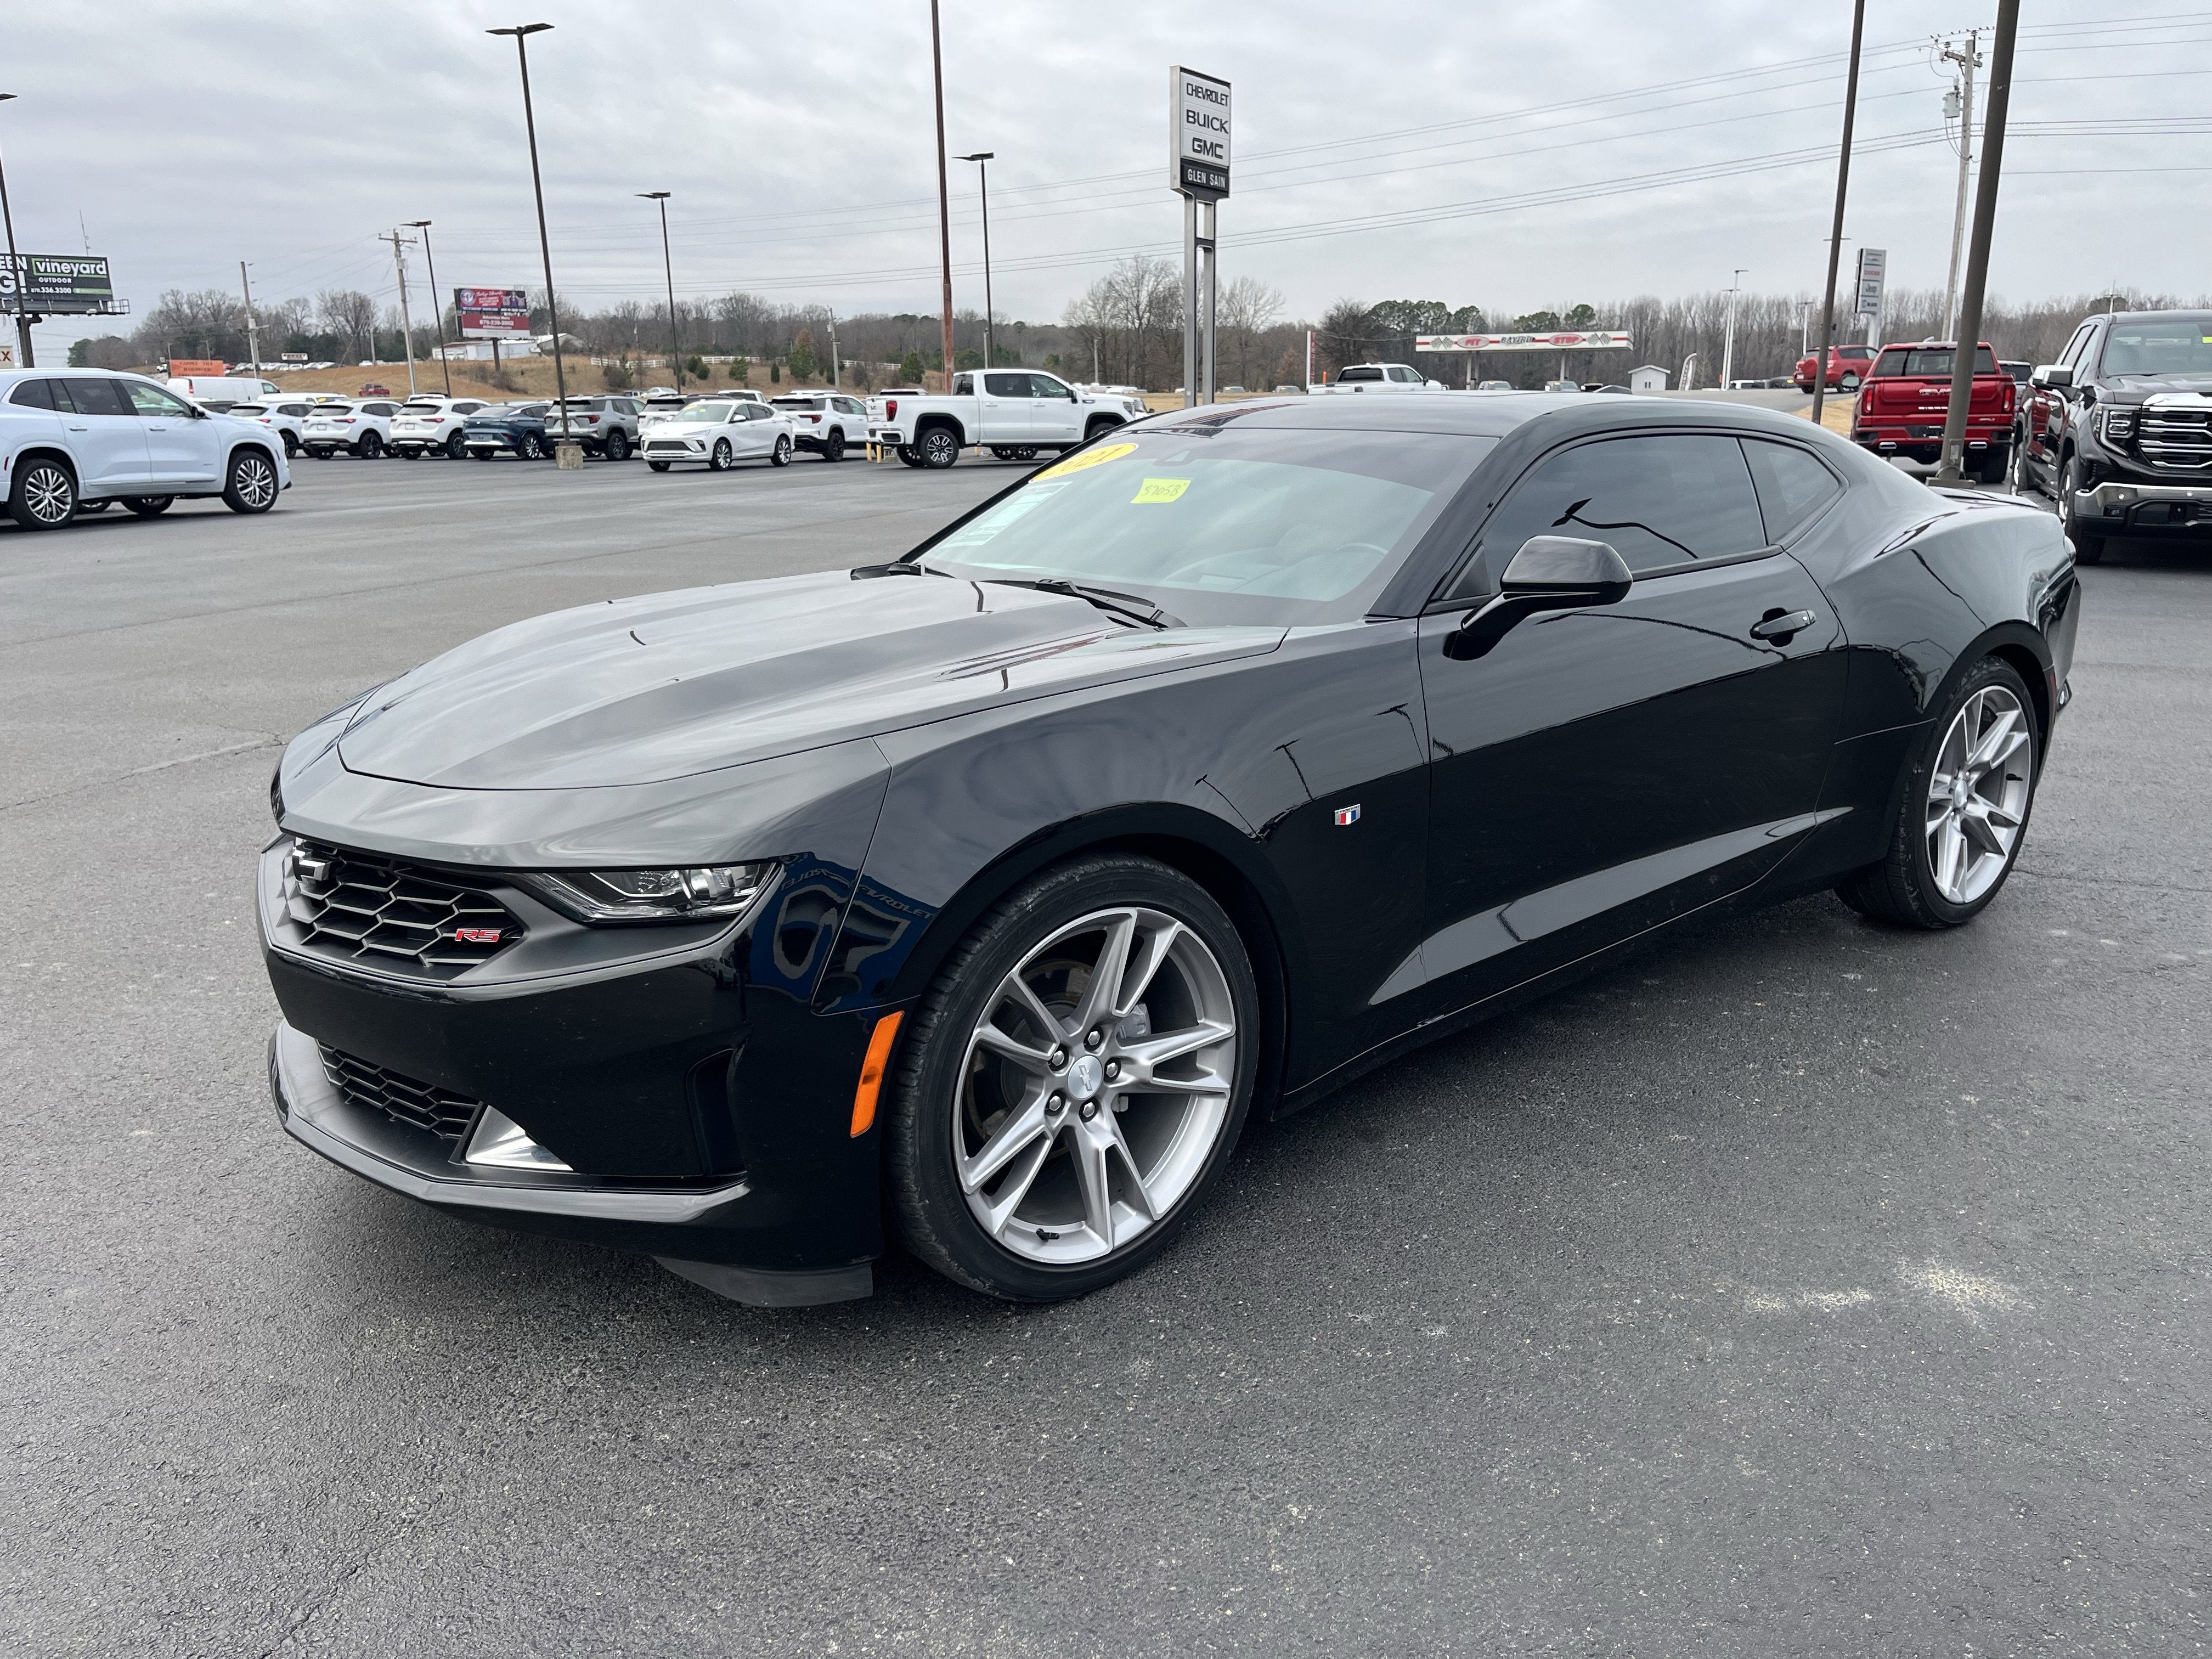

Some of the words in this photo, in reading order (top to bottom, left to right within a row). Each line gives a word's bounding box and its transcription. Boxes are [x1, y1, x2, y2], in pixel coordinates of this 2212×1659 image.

[1187, 83, 1229, 106] CHEVROLET
[1186, 109, 1229, 134] BUICK
[1192, 137, 1223, 159] GMC
[1187, 168, 1206, 184] GLEN
[1209, 173, 1226, 188] SAIN
[36, 258, 107, 277] vineyard
[0, 351, 12, 362] X
[454, 928, 501, 943] RS
